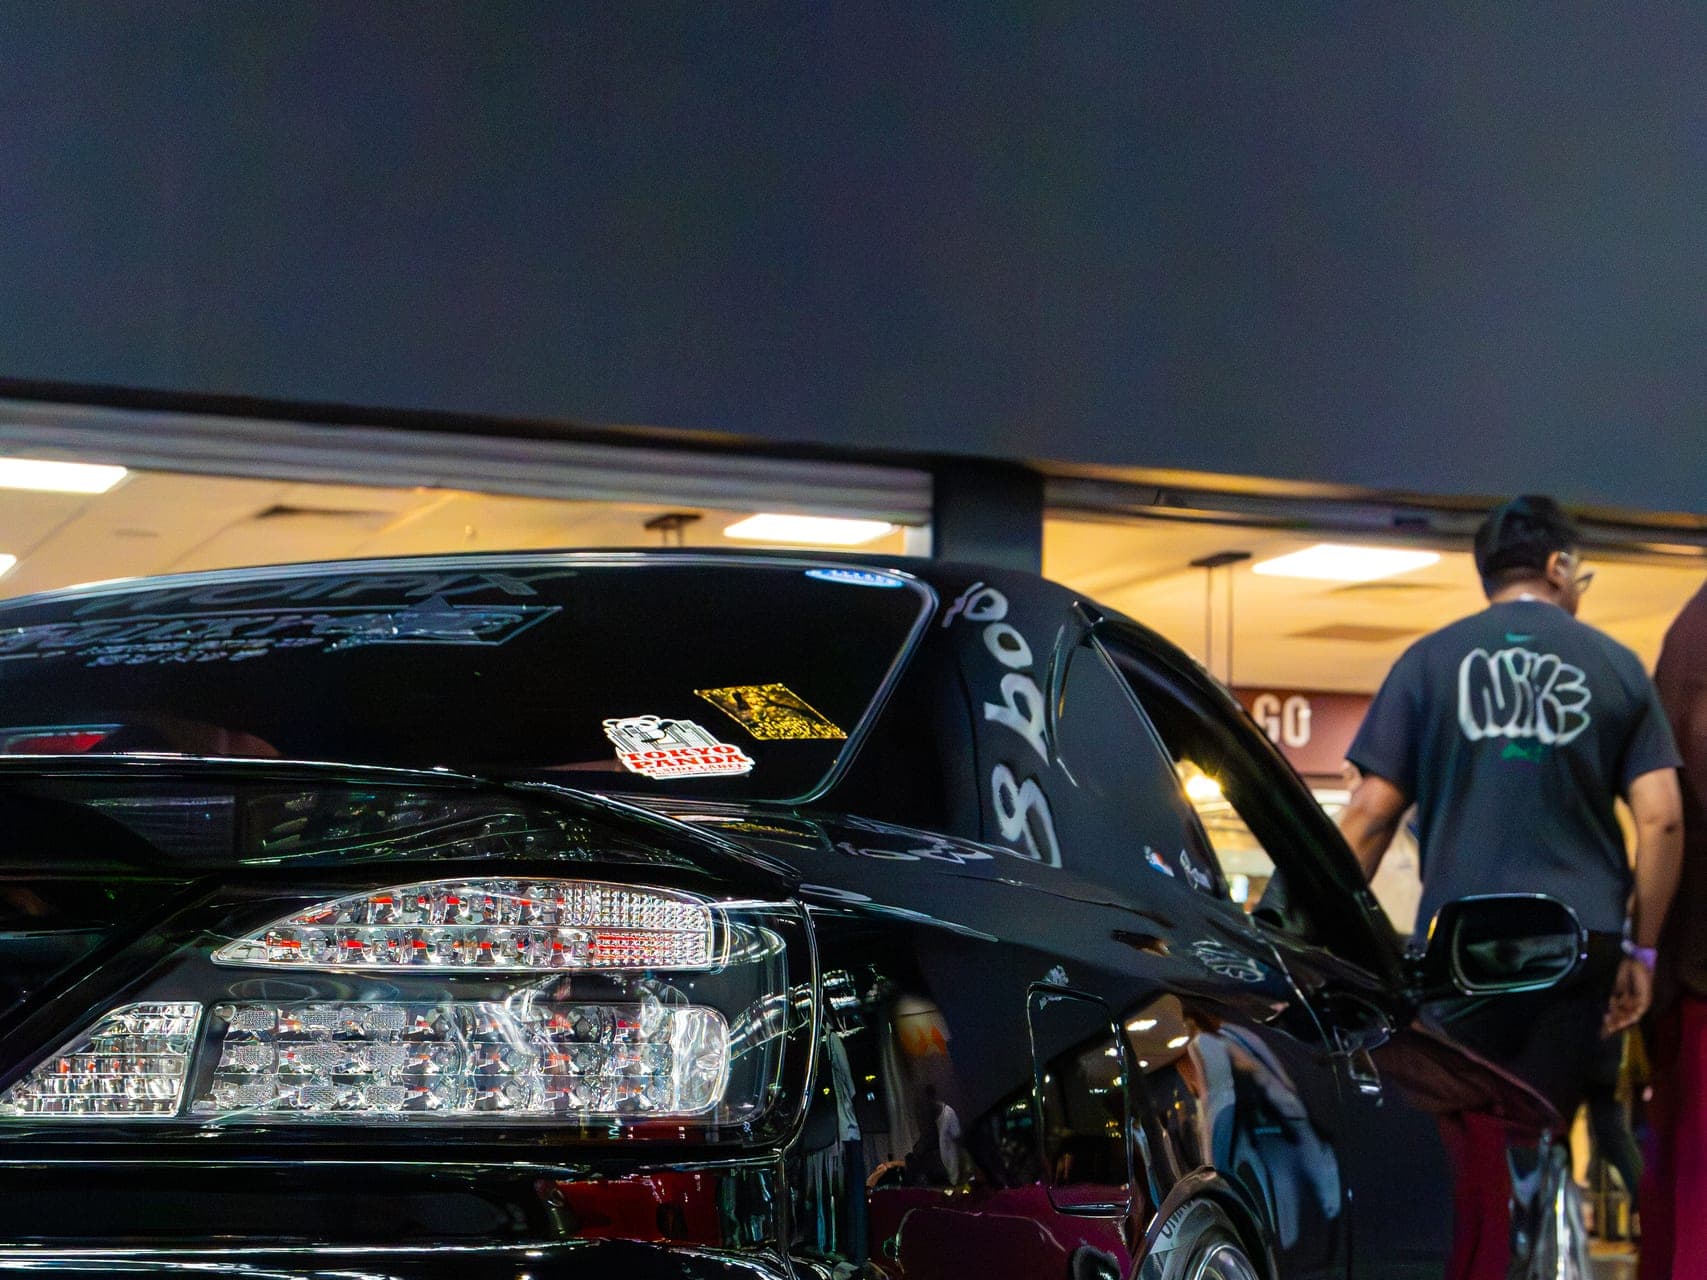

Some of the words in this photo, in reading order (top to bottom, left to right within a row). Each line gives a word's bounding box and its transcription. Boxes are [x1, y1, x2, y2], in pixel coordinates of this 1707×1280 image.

[1252, 693, 1312, 748] GO
[625, 745, 736, 761] TOKYO
[631, 754, 749, 770] PANDA
